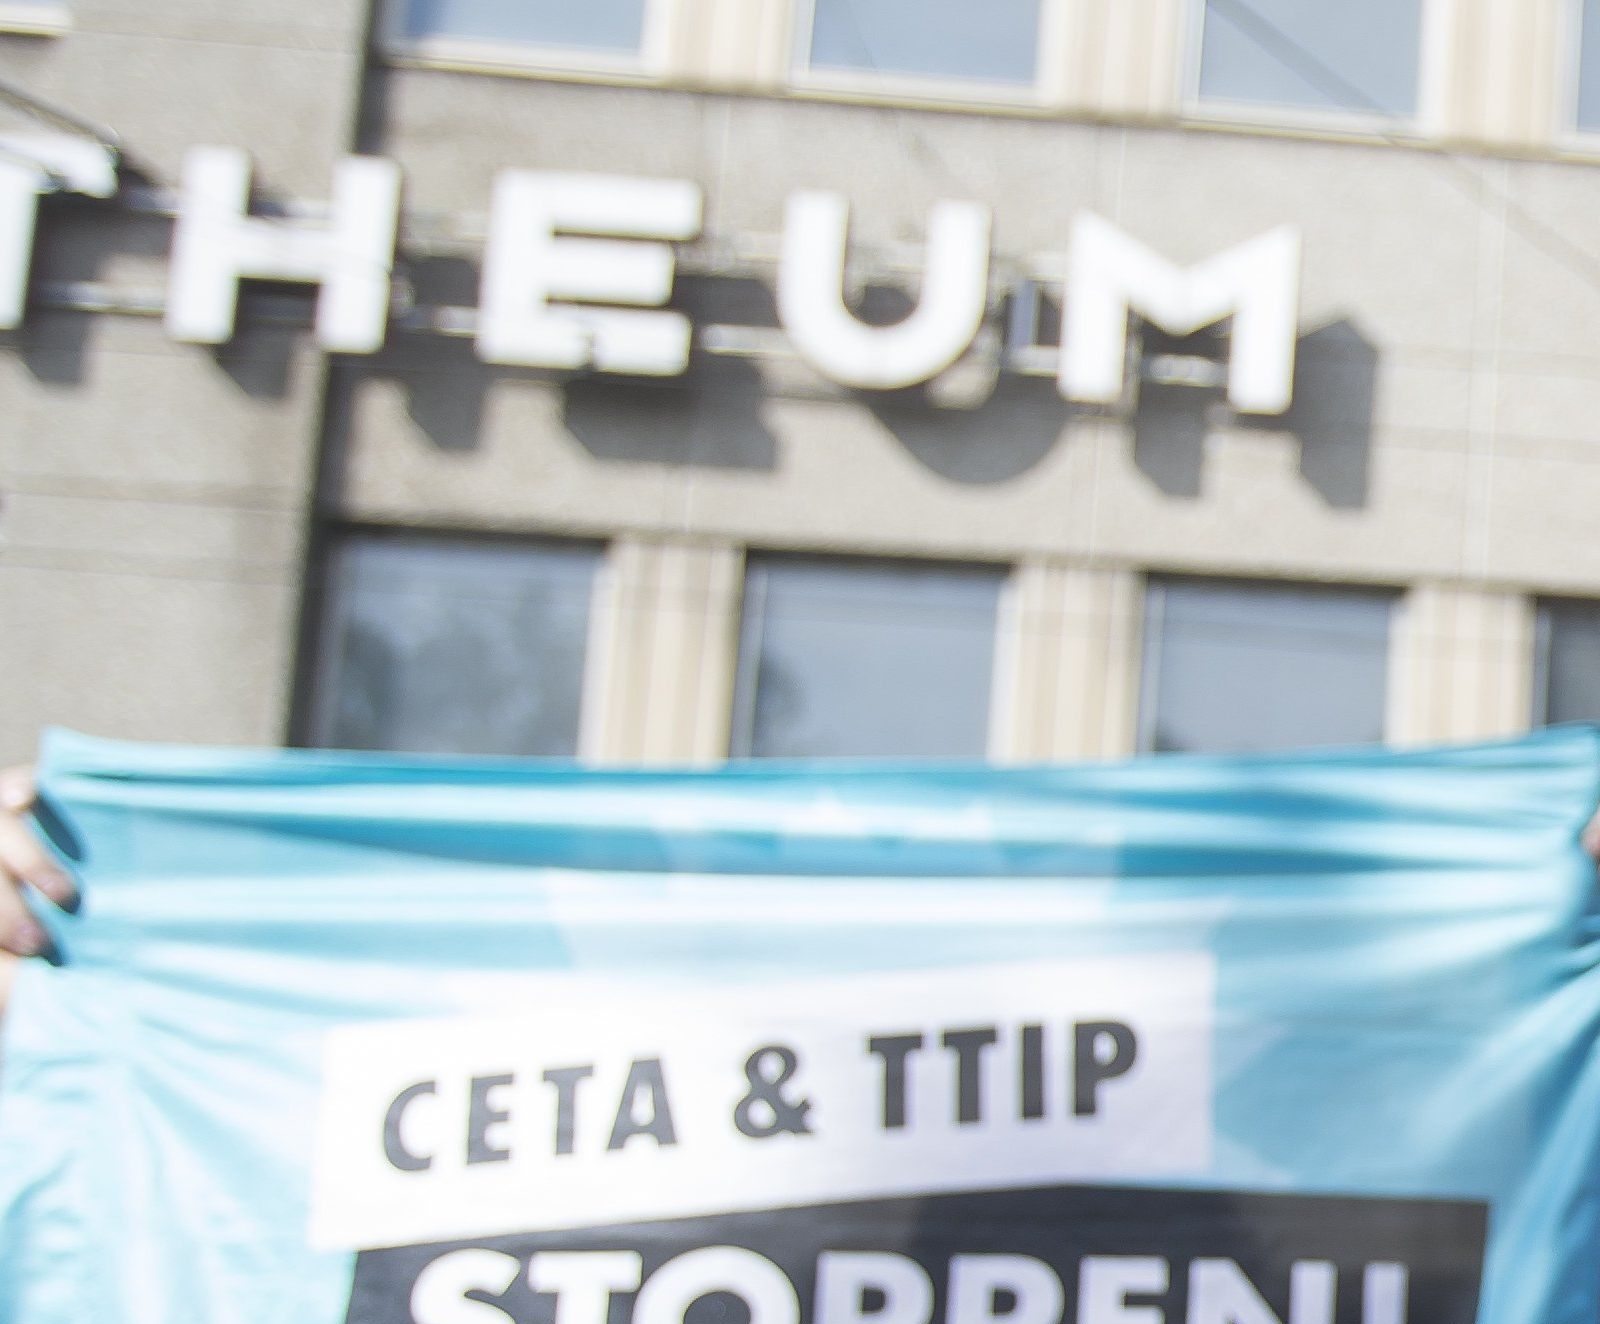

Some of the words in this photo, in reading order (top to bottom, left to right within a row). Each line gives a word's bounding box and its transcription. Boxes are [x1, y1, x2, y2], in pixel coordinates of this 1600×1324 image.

[382, 1058, 680, 1172] CETA
[731, 1044, 814, 1140] &
[866, 1018, 1141, 1133] TTIP
